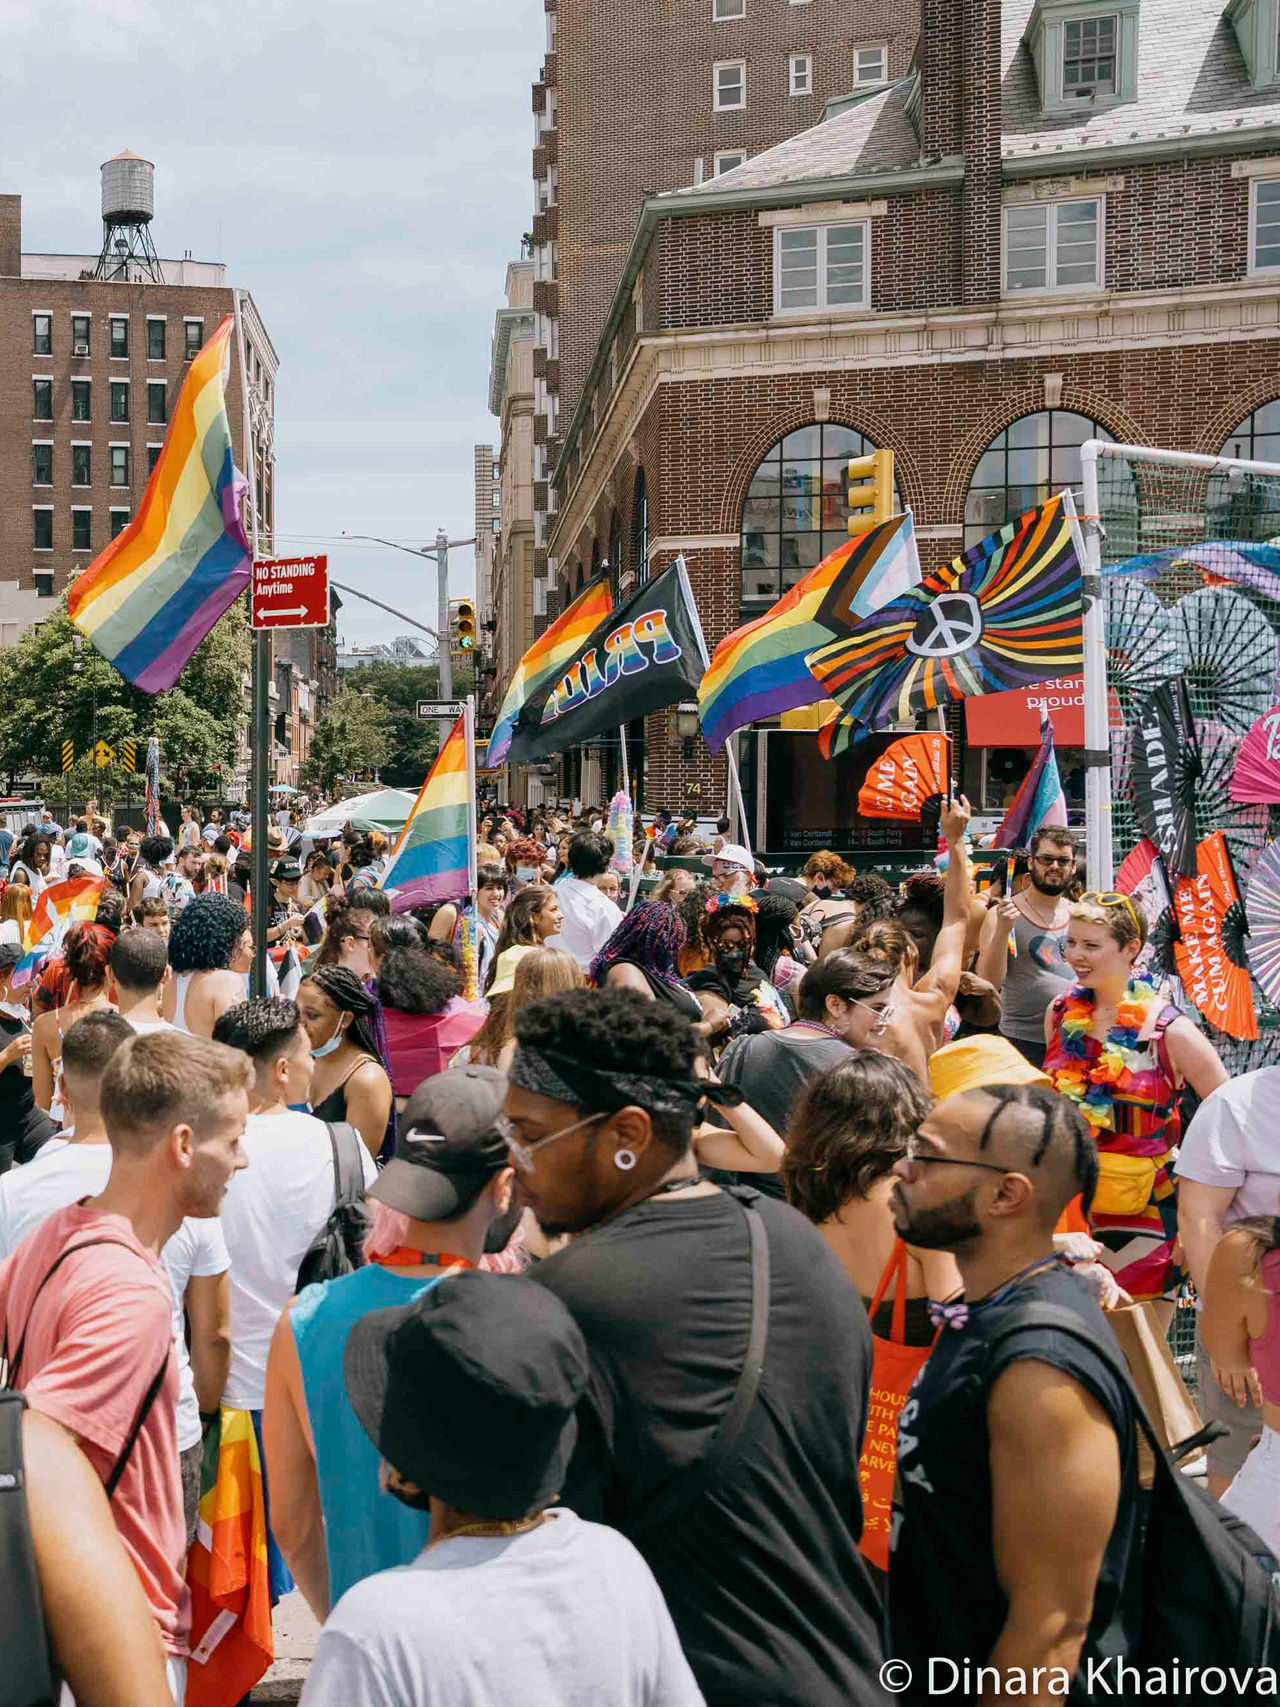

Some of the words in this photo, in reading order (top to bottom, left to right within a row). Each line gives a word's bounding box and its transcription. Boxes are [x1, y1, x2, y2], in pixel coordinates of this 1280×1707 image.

[256, 567, 269, 580] NO
[270, 563, 315, 579] STANDING
[256, 581, 293, 598] Anytime
[422, 706, 440, 714] ONE
[685, 782, 701, 795] 74
[877, 759, 896, 792] ME
[900, 755, 918, 812] GAIN
[1179, 887, 1197, 926] ME
[1196, 873, 1219, 950] AGAIN
[1184, 930, 1209, 1006] MAKE
[1208, 955, 1228, 1012] CUM
